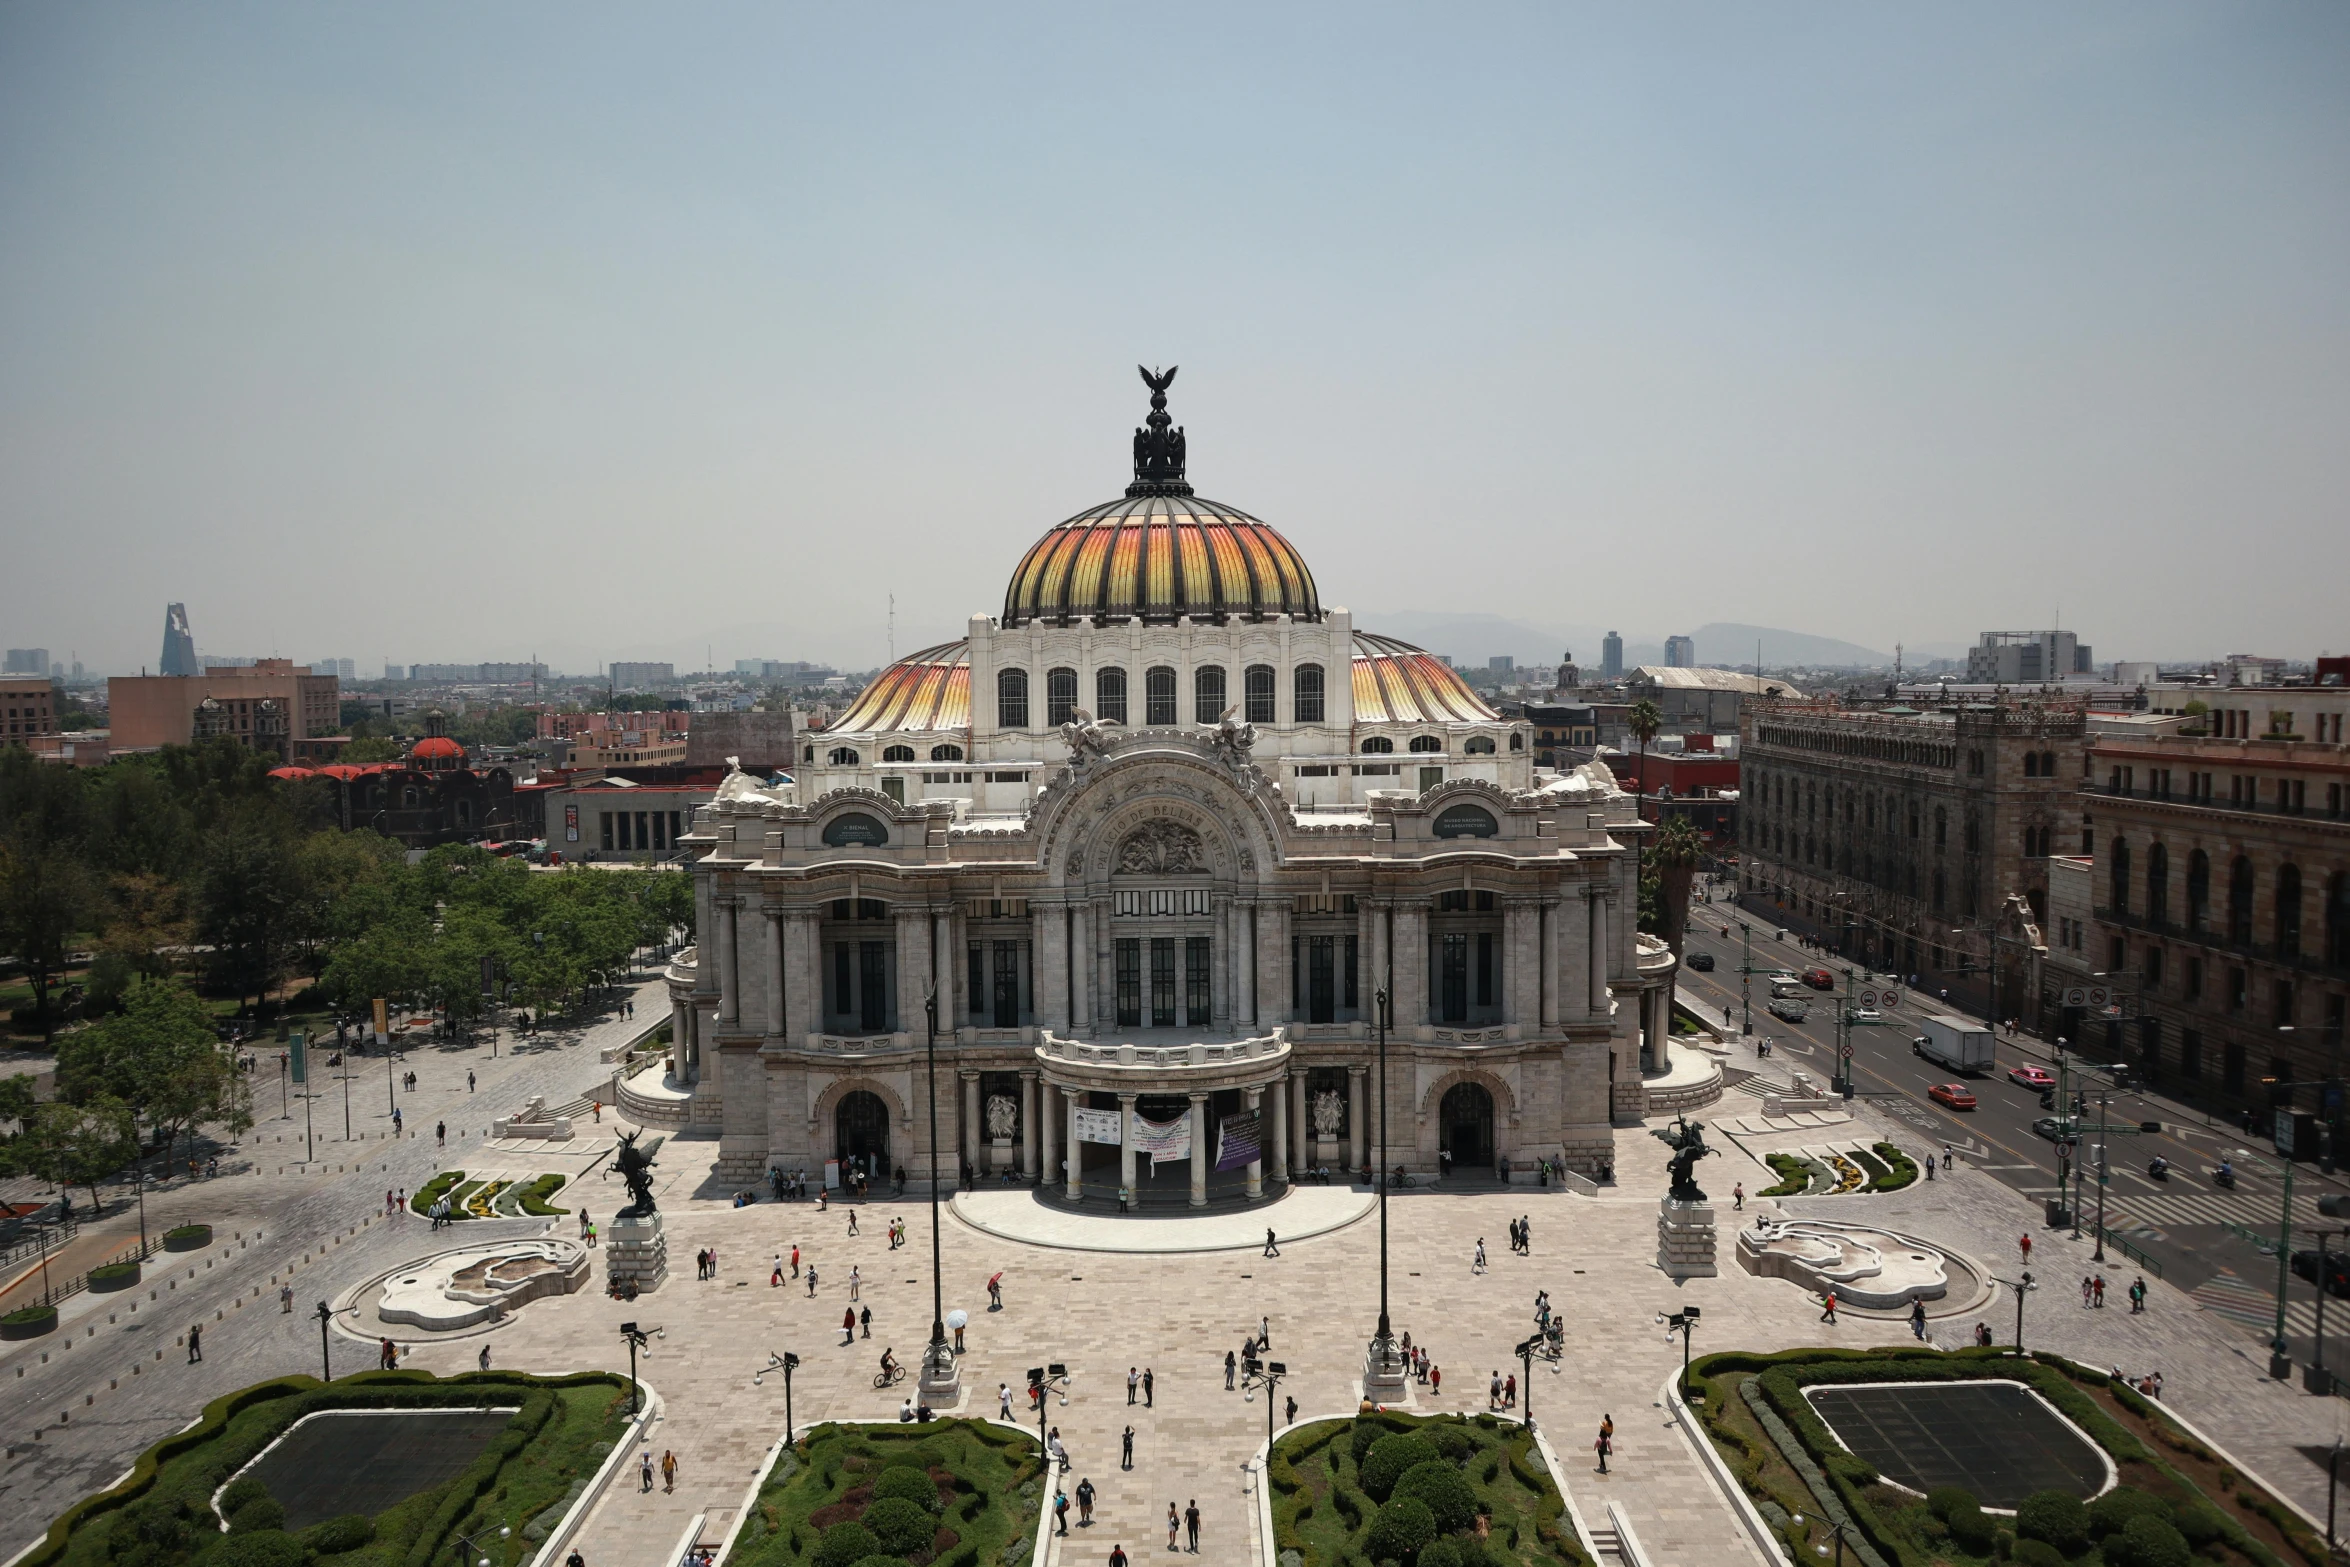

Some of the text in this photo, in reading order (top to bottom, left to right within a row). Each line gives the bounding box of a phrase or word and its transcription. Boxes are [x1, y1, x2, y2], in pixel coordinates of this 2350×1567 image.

[1097, 805, 1226, 870] PALACIO DE BELLAS ARTES
